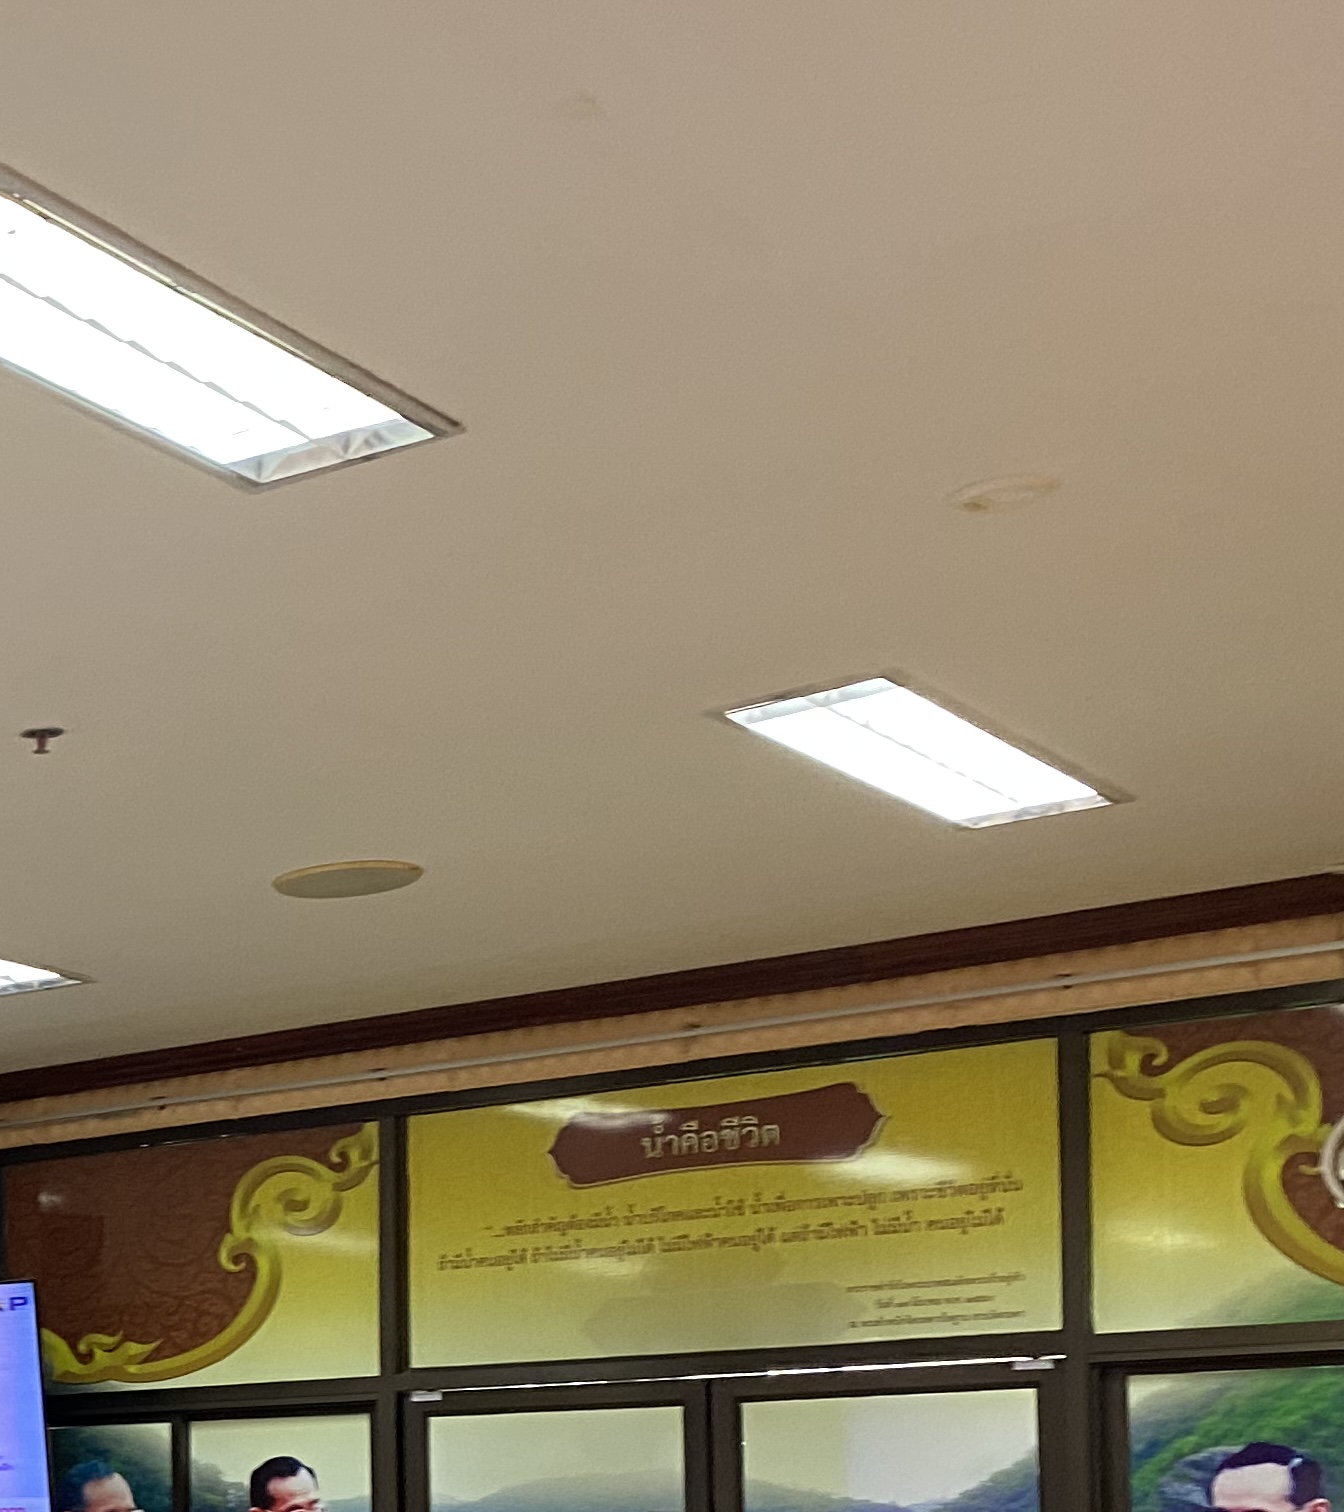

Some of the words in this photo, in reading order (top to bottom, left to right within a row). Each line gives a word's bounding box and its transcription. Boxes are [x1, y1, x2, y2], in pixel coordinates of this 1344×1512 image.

[640, 1115, 781, 1159] น้ำคือชีวิต
